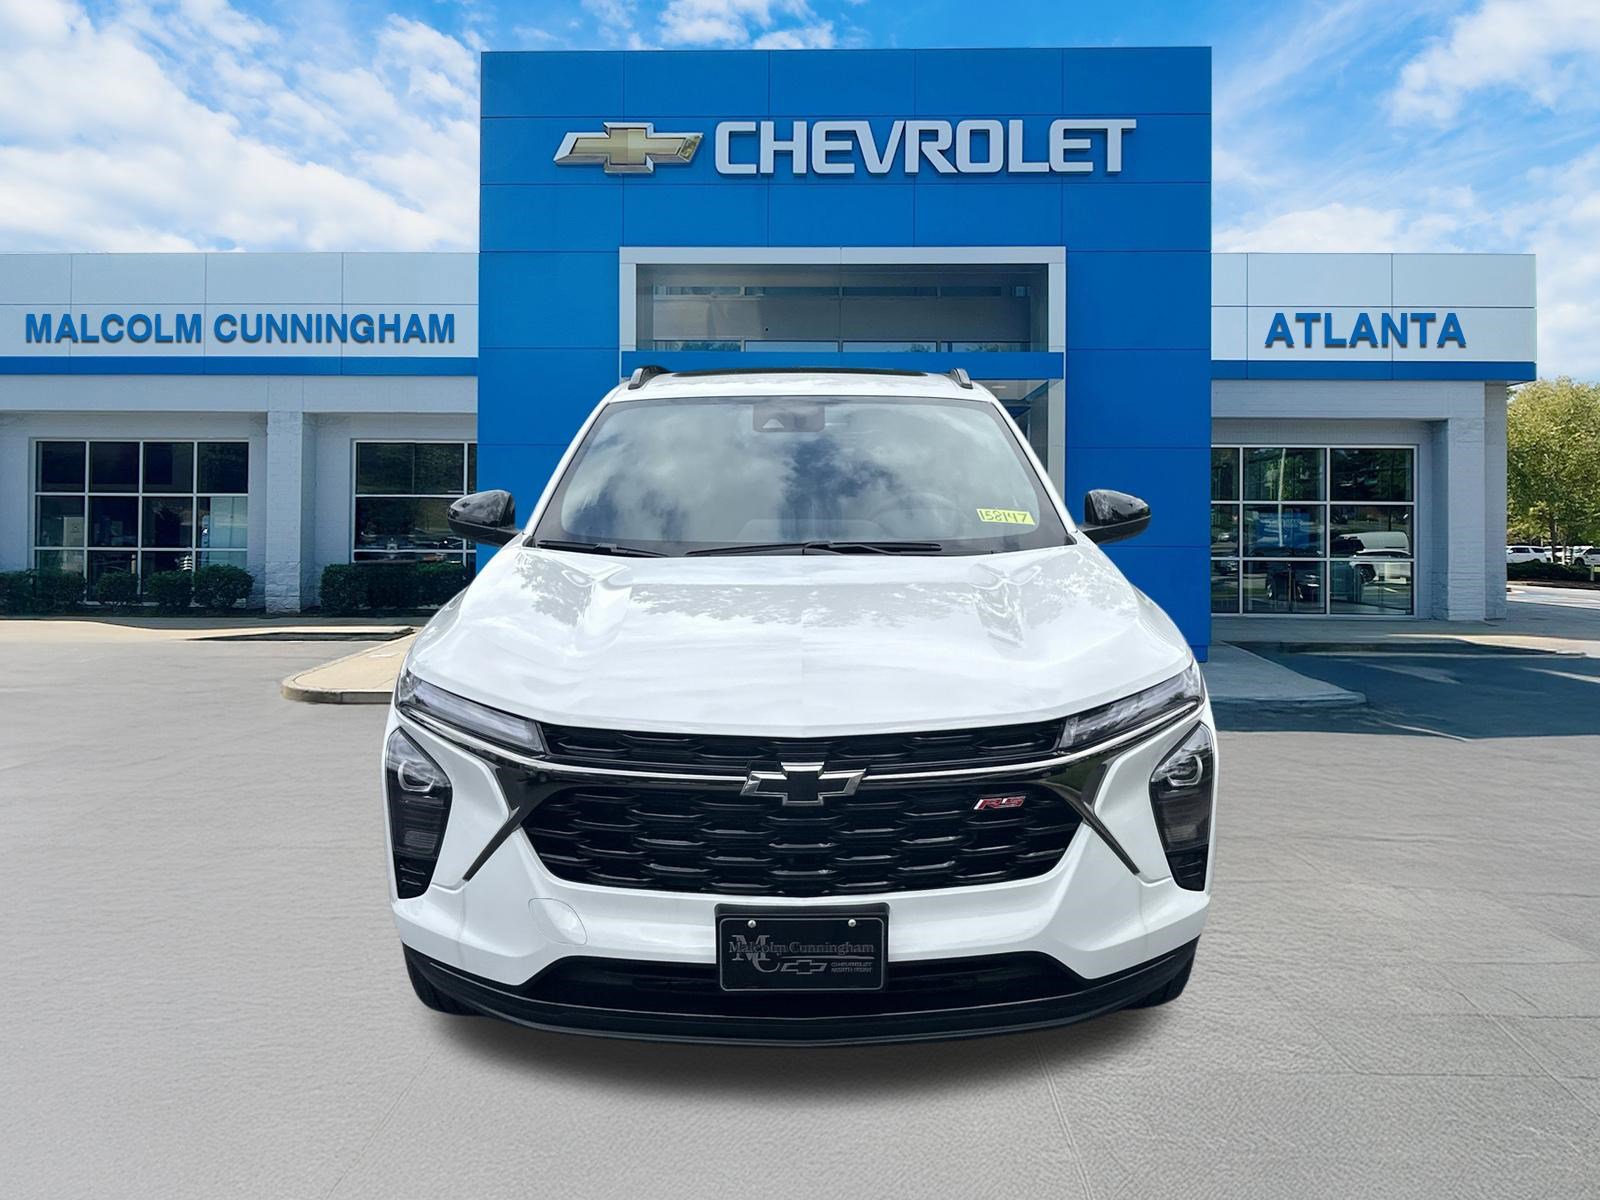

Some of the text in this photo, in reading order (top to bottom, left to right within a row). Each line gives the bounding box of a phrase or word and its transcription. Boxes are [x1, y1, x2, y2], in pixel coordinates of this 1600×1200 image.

[715, 119, 1137, 174] CHEVROLET
[26, 313, 456, 343] MALCOLM CUNNINGHAM
[1264, 312, 1467, 348] ATLANTA
[973, 796, 1026, 810] RS
[729, 941, 874, 955] Malcolm Cunningham
